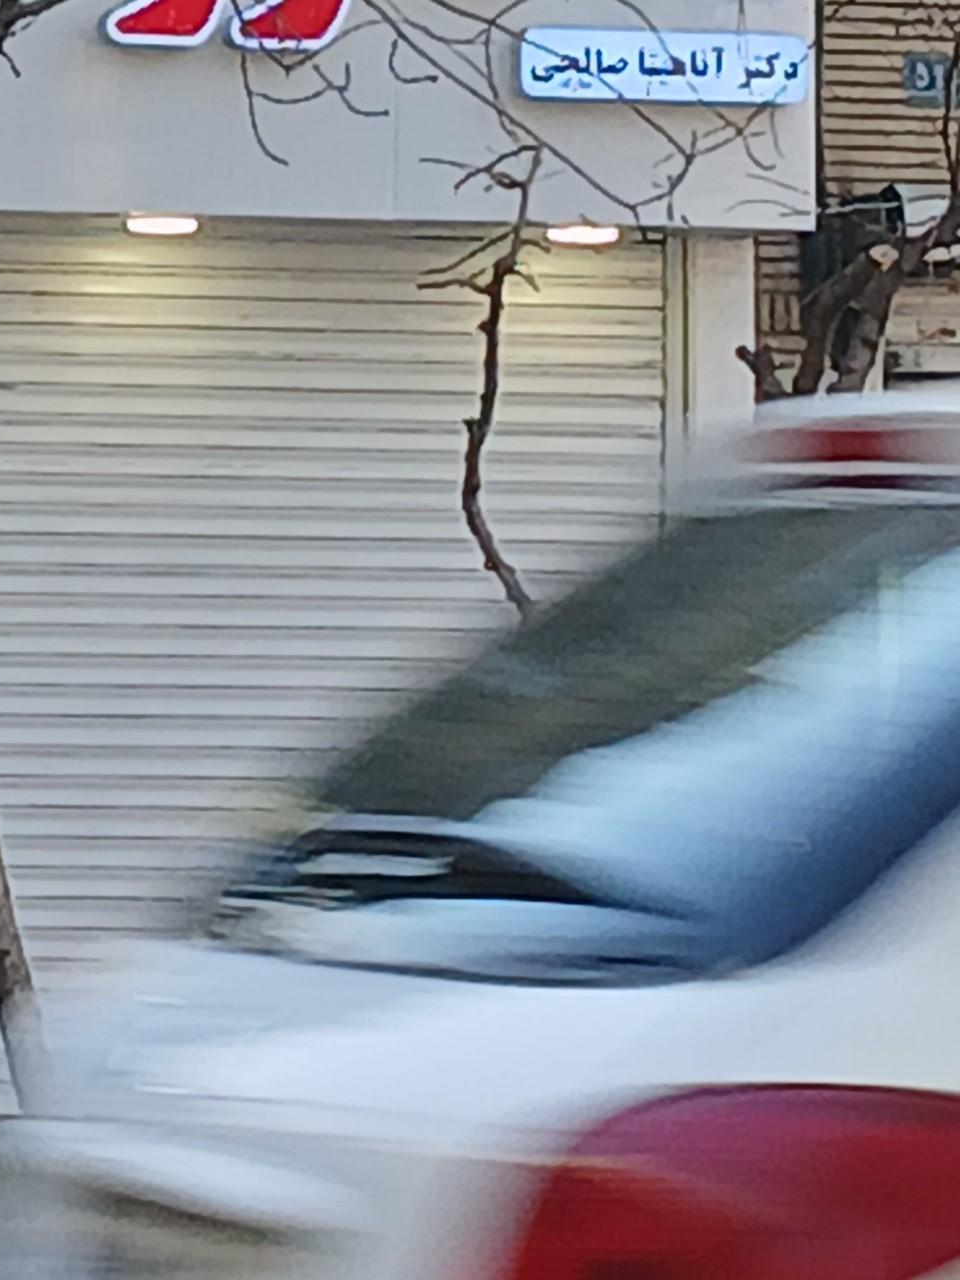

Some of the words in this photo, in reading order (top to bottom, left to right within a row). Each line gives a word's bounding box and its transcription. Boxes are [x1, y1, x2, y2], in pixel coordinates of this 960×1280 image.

[530, 46, 629, 86] صالحی
[638, 46, 725, 86] آناهیتا
[737, 51, 799, 89] دکتر
